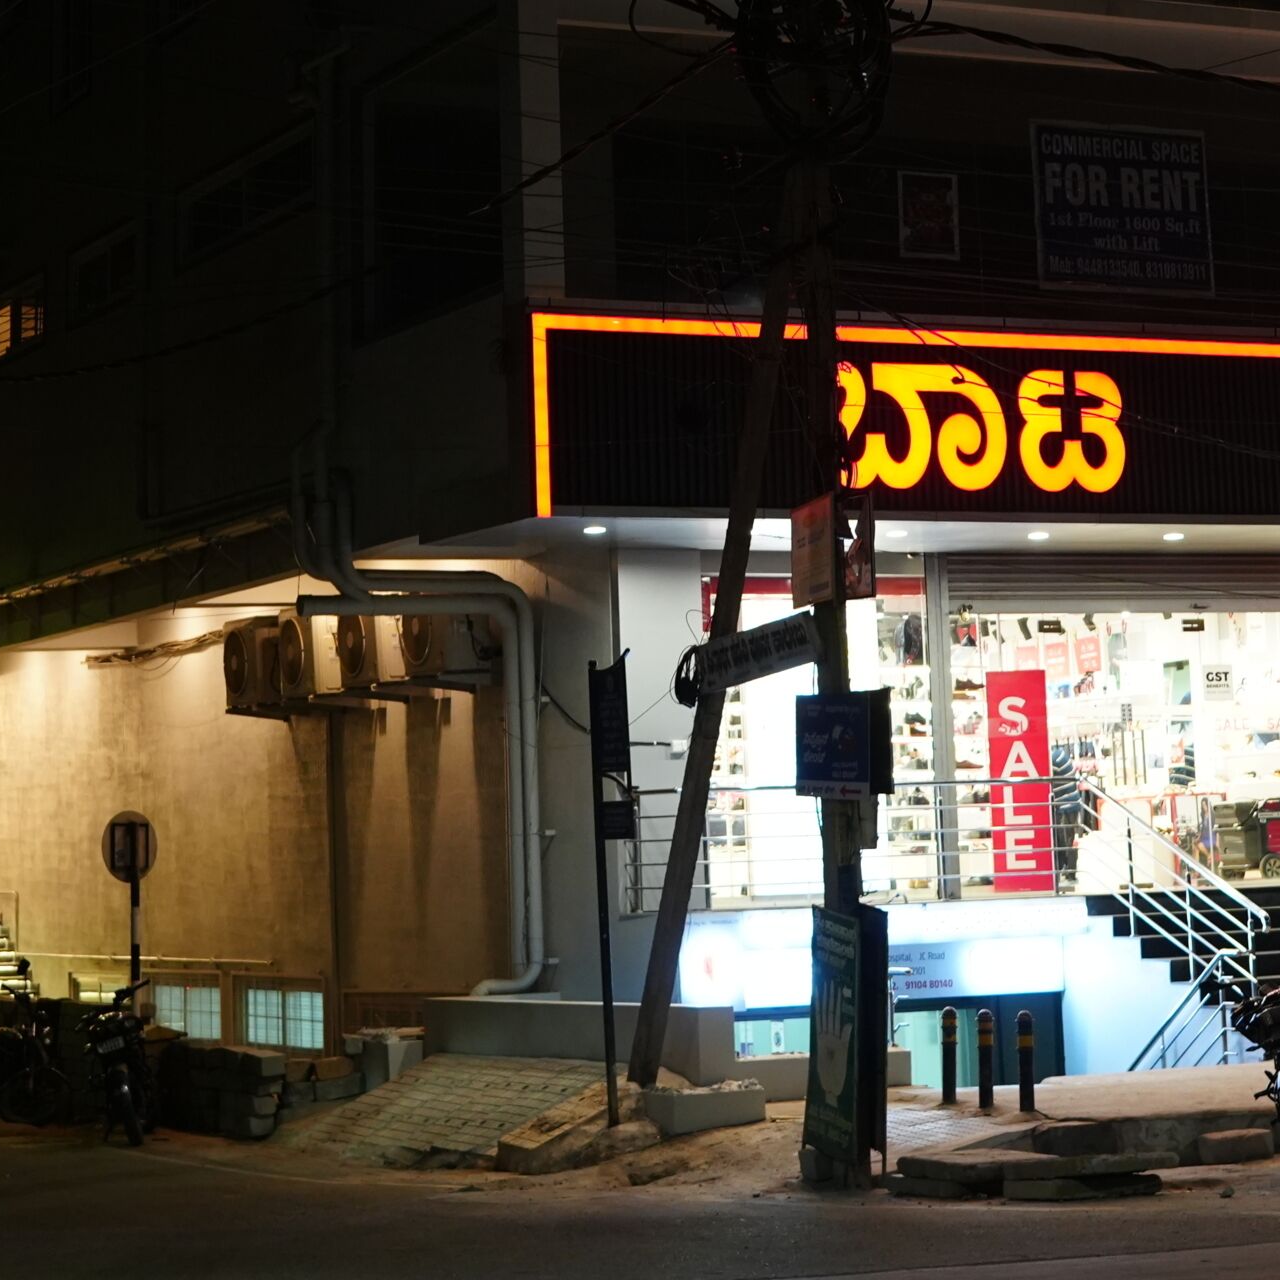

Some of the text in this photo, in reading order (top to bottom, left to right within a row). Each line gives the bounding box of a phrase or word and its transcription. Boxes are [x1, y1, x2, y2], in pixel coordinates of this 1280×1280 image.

[1040, 132, 1200, 164] COMMERCIAL SPACE
[1043, 161, 1201, 212] FOR RENT
[1048, 211, 1073, 227] 1st
[1077, 213, 1119, 230] Floor
[1092, 233, 1161, 253] with Lift
[1048, 255, 1075, 273] Mob:
[1205, 671, 1230, 682] GST
[998, 695, 1039, 871] SALE
[927, 951, 946, 960] Road
